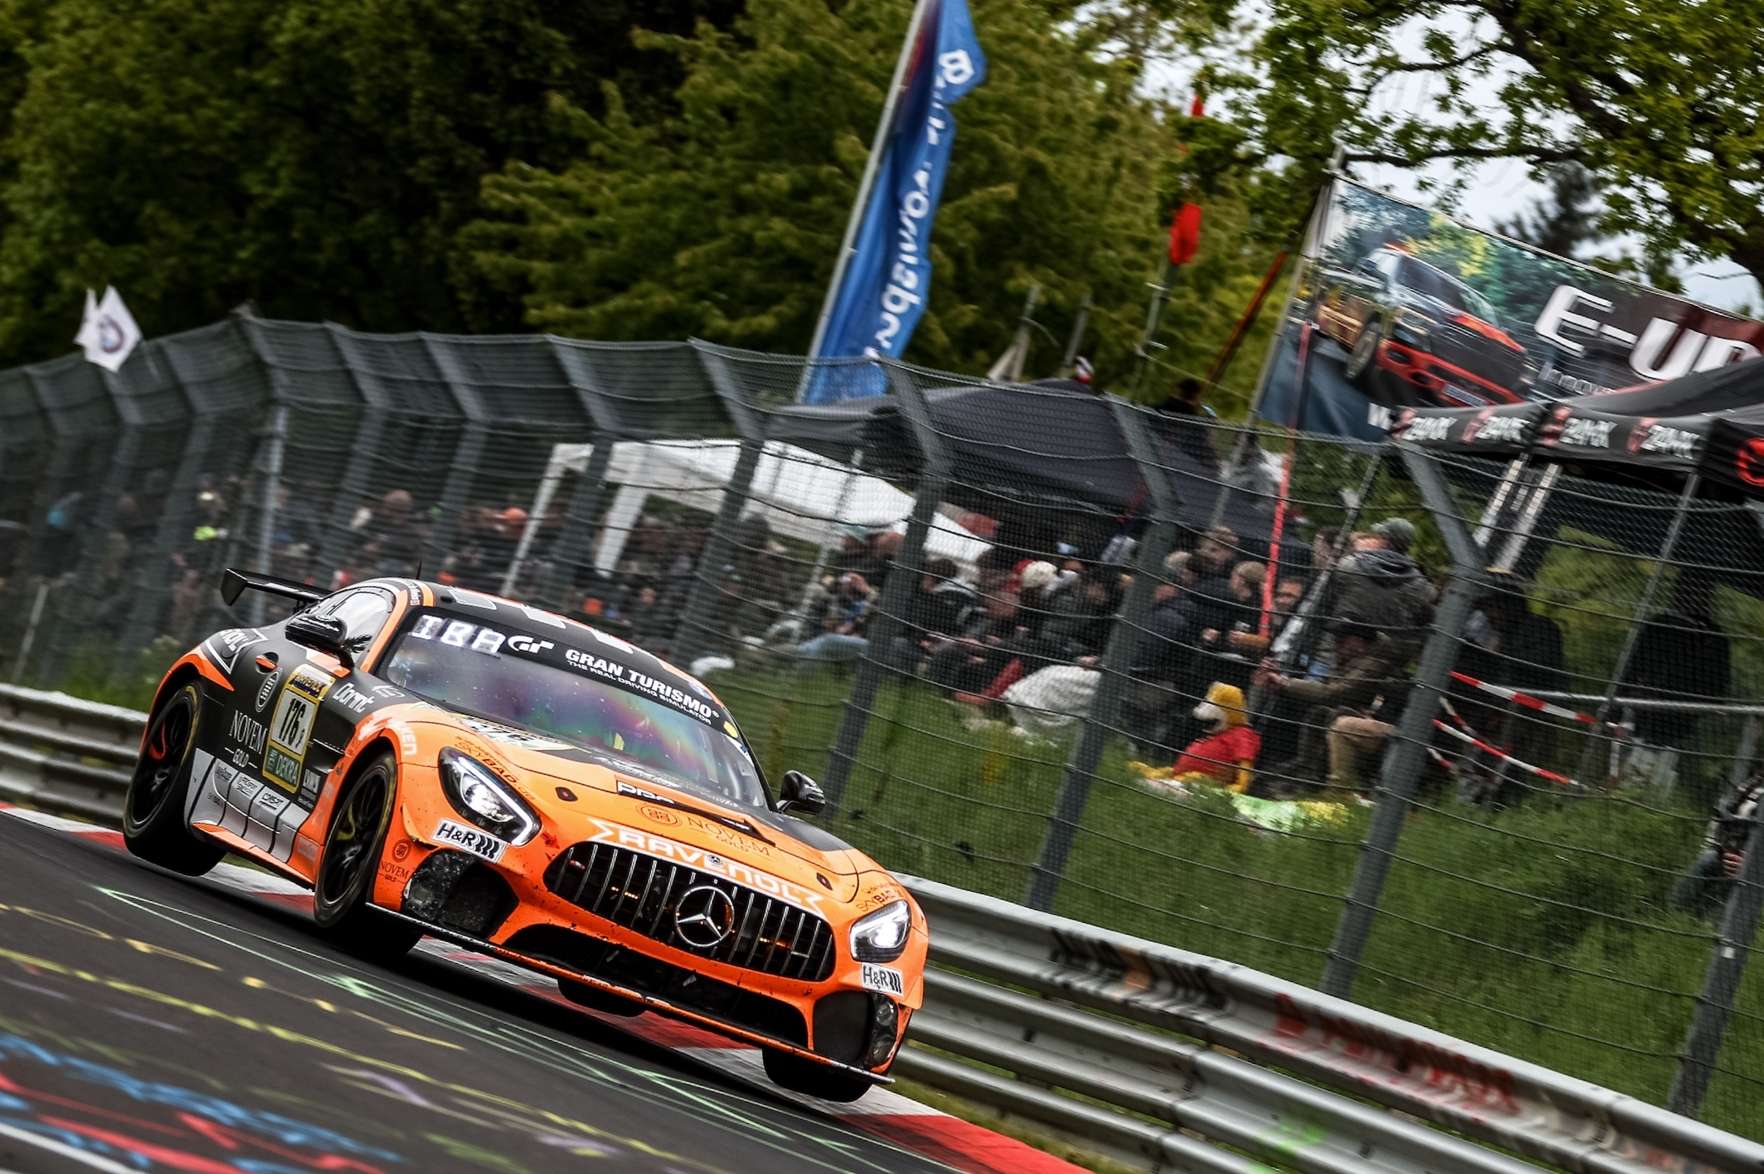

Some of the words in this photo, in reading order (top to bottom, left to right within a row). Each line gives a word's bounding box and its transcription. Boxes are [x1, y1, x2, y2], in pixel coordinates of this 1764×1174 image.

[565, 649, 623, 676] GRAN
[568, 660, 588, 671] THE
[590, 666, 617, 681] REAL
[618, 676, 658, 698] DRIVING
[659, 694, 712, 726] SIMULATOR
[229, 709, 268, 755] NOVEM
[381, 861, 411, 880] NOVEM
